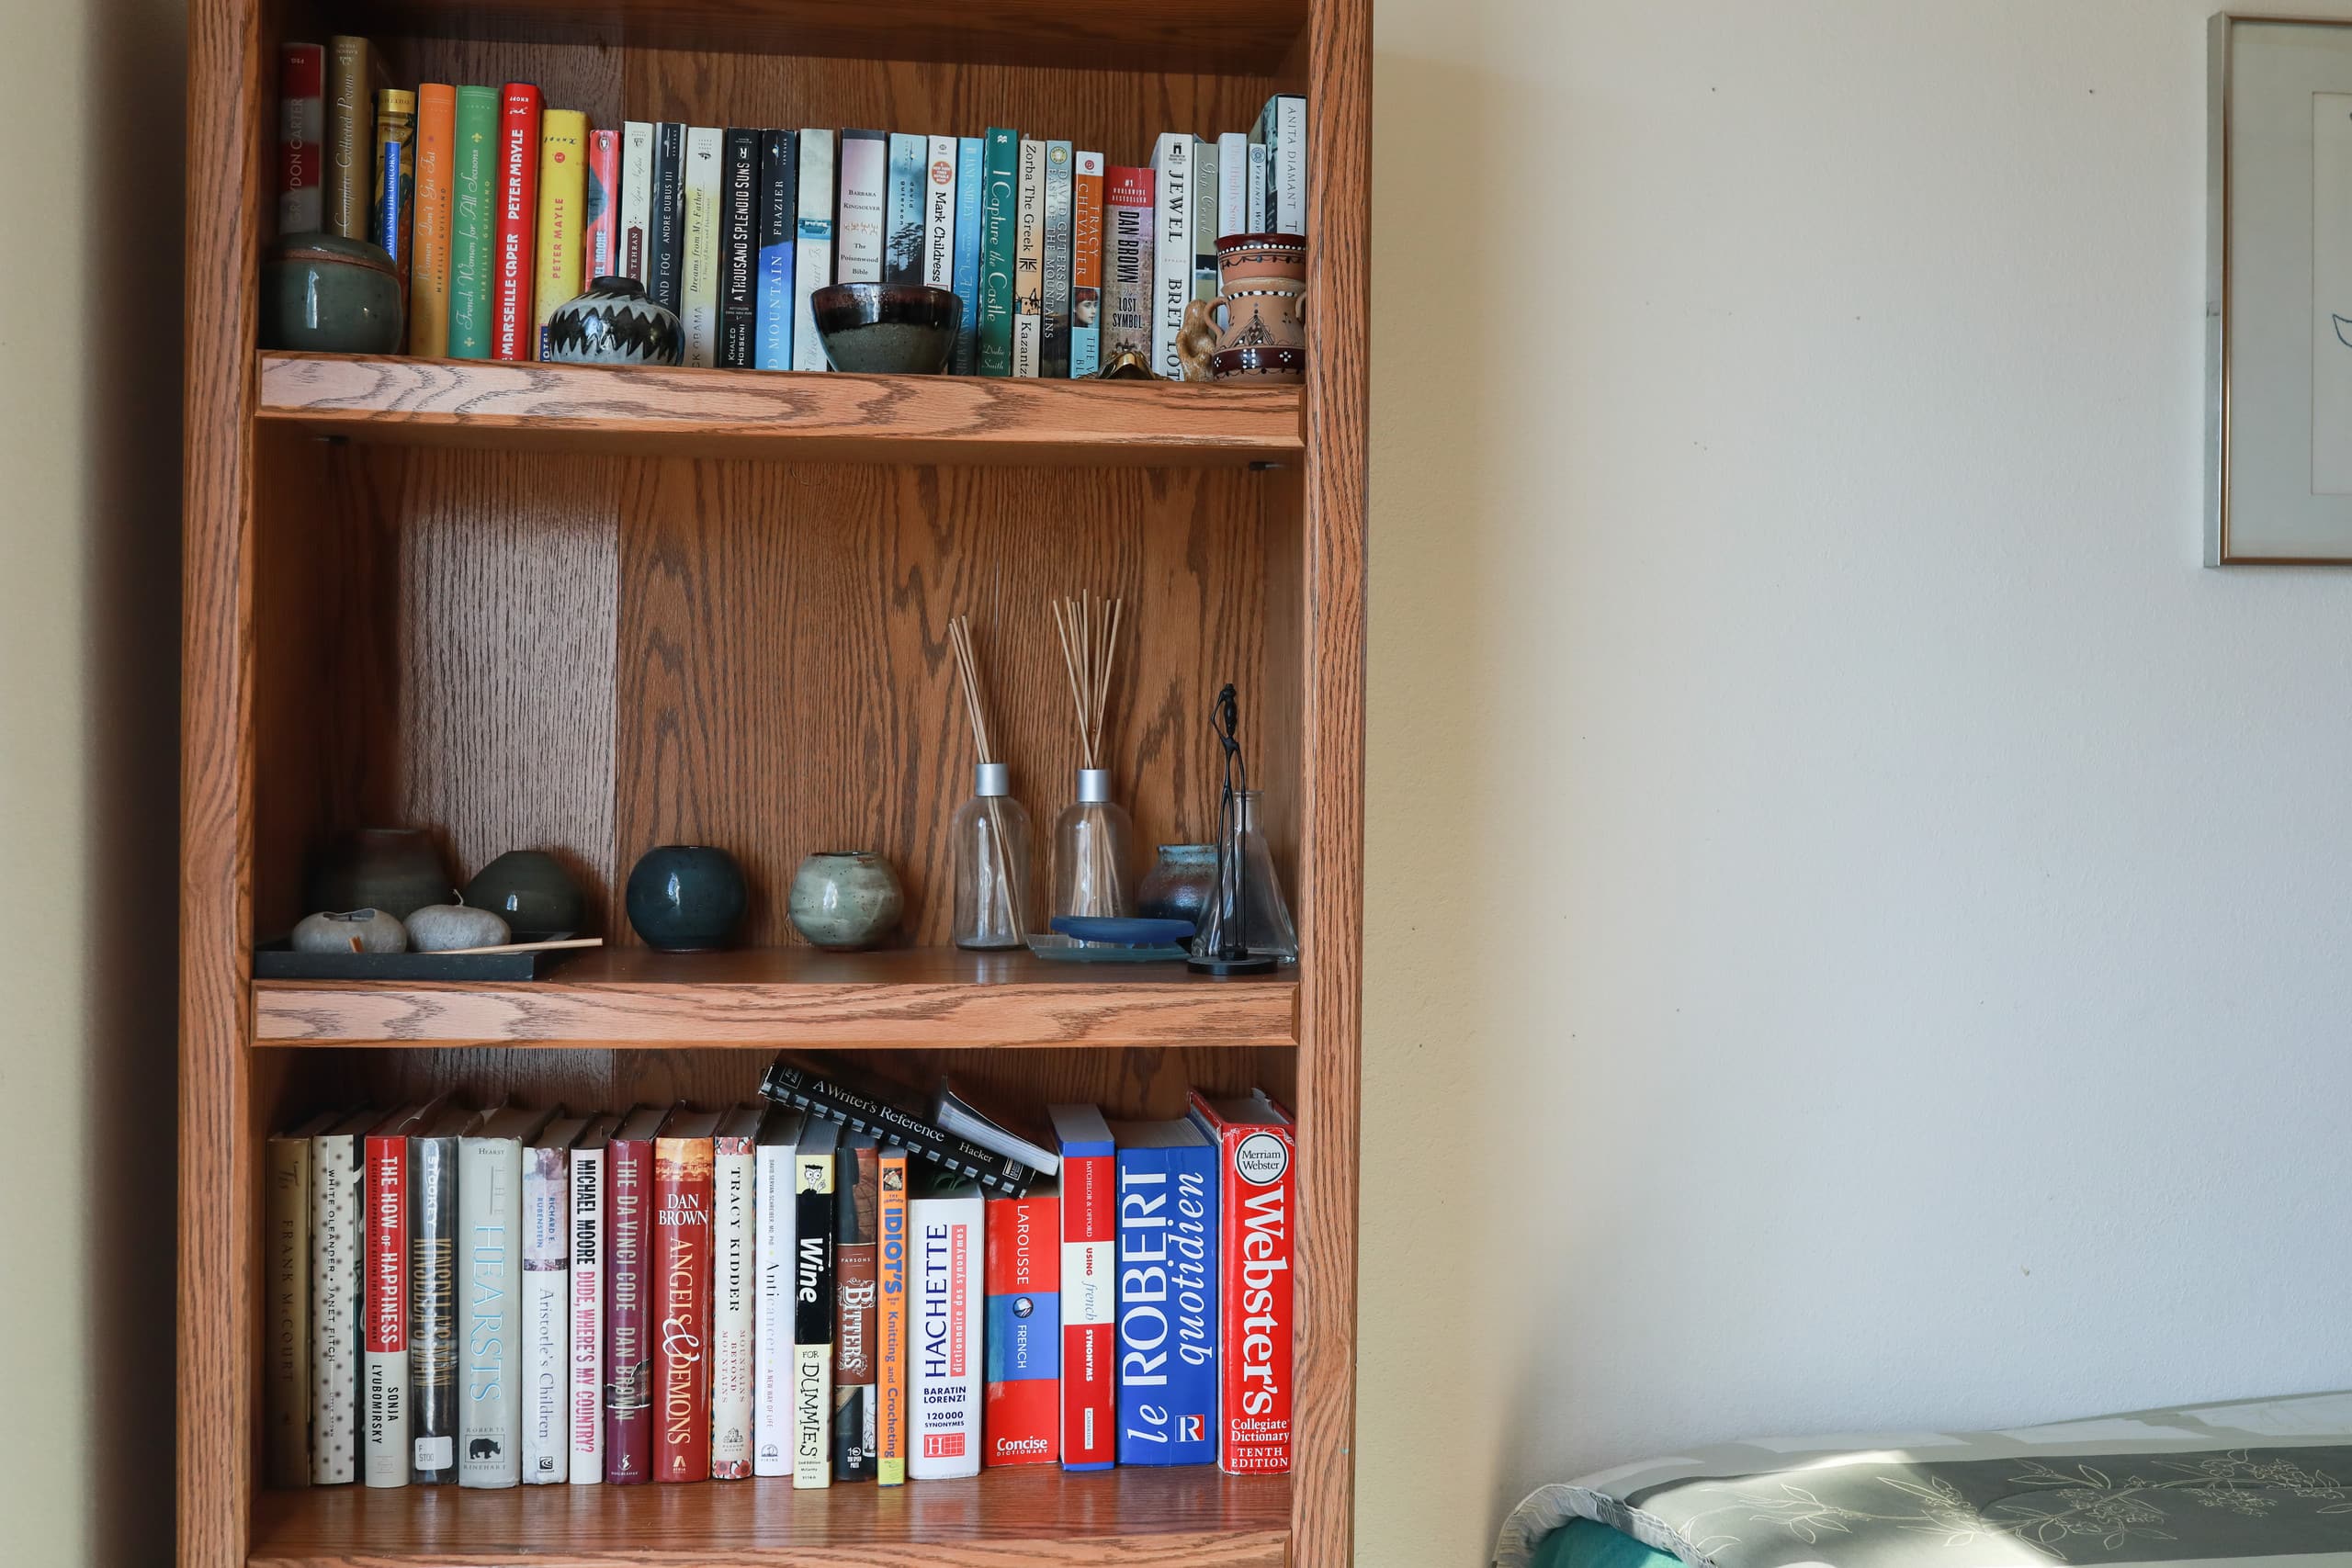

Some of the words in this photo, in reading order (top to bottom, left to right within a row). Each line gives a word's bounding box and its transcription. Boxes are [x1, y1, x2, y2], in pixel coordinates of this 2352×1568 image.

[336, 73, 355, 110] Poems
[289, 97, 303, 151] CARTER
[335, 116, 355, 168] Collected
[1286, 106, 1297, 148] ANITA
[386, 153, 397, 192] UNICORN
[460, 149, 479, 190] Seasons
[508, 129, 524, 177] MAYLE
[1024, 143, 1036, 181] Zorba
[664, 171, 673, 182] III
[734, 162, 751, 188] SUNS
[848, 189, 876, 197] BARBARA
[1047, 168, 1057, 198] EAST
[1113, 187, 1147, 197] WORLDWIDE
[1125, 178, 1134, 187] #1
[1254, 164, 1262, 206] VIRGINIA
[1286, 152, 1297, 209] DIAMANT
[459, 196, 478, 220] All
[481, 180, 491, 238] GUILIANO
[508, 176, 522, 220] PETER
[664, 184, 673, 212] DUBUS
[692, 186, 703, 218] Father
[732, 190, 750, 240] SPLENDID
[774, 180, 784, 235] FRAZIER
[843, 203, 880, 211] KINGSOLVER
[935, 191, 946, 222] Mark
[987, 181, 1012, 245] Capture
[1024, 185, 1035, 209] The
[1047, 207, 1057, 220] OF
[1112, 195, 1147, 204] BESTSELLER
[1168, 169, 1185, 243] JEWEL
[553, 197, 564, 240] MAYLE
[662, 215, 672, 243] ANDRE
[1023, 213, 1035, 252] Greek
[1077, 183, 1088, 276] CHEVALIER
[1088, 205, 1101, 256] TRACY
[1117, 209, 1140, 236] DAN
[503, 233, 519, 279] CAPER
[692, 236, 702, 257] from
[841, 254, 879, 263] Poisonwood
[933, 226, 946, 282] Childress
[1046, 227, 1057, 251] THE
[457, 242, 477, 286] Women
[481, 246, 489, 300] MIREILLE
[551, 243, 562, 279] PETER
[660, 252, 671, 276] FOG
[689, 259, 701, 293] Dreams
[731, 242, 748, 293] THOUSAND
[1056, 221, 1067, 302] GUTERSON
[1116, 239, 1139, 285] BROWN
[456, 290, 474, 330] French
[659, 280, 670, 305] AND
[768, 255, 783, 349] MOUNTAIN
[987, 272, 1008, 322] Castle
[1045, 258, 1057, 338] MOUNTAINS
[1119, 297, 1137, 313] LOST
[1167, 277, 1182, 331] BRET
[502, 279, 517, 353] MARSEILLE
[1112, 312, 1144, 330] SYMBOL
[728, 327, 736, 361] KHALED
[737, 323, 746, 366] HOSSEINI
[1086, 335, 1096, 361] THE
[813, 1080, 826, 1093] A
[828, 1084, 878, 1114] Writer's
[879, 1105, 946, 1143] Reference
[959, 1141, 994, 1164] Hacker
[380, 1156, 398, 1186] THE
[478, 1147, 505, 1156] HEARST
[1239, 1149, 1282, 1160] Merriam
[1241, 1159, 1283, 1171] Webster
[576, 1159, 596, 1215] MICHAEL
[616, 1158, 638, 1188] THE
[380, 1192, 398, 1228] HOW
[548, 1197, 556, 1235] RICHARD
[658, 1210, 709, 1226] BROWN
[667, 1193, 699, 1209] DAN
[729, 1167, 741, 1229] TRACY
[327, 1210, 335, 1272] OLEANDER
[381, 1235, 391, 1247] OF
[536, 1197, 545, 1248] RUBENSTEIN
[548, 1235, 555, 1244] E.
[575, 1219, 595, 1265] MOORE
[616, 1220, 638, 1265] VINCI
[883, 1207, 903, 1295] IDIOT'S
[956, 1227, 966, 1282] synonymes
[1017, 1204, 1030, 1286] LAROUSSE
[1085, 1247, 1093, 1277] USING
[668, 1236, 694, 1325] ANGELS
[729, 1237, 741, 1313] KIDDER
[800, 1237, 824, 1303] Wine
[1121, 1166, 1169, 1386] ROBERT
[1167, 1171, 1212, 1365] quotidien
[327, 1287, 335, 1324] JANET
[380, 1252, 398, 1344] HAPPINESS
[615, 1267, 637, 1312] CODE
[763, 1259, 781, 1356] Anticancer
[925, 1224, 947, 1378] HACHETTE
[955, 1283, 965, 1303] des
[1081, 1280, 1097, 1321] french
[1242, 1180, 1288, 1416] Webster's
[469, 1220, 507, 1403] HEARSTS
[538, 1287, 554, 1367] Aristotle's
[326, 1327, 334, 1362] FITCH
[575, 1308, 594, 1362] WHERE'S
[615, 1326, 636, 1358] DAN
[802, 1349, 820, 1359] FOR
[885, 1310, 899, 1363] Knitting
[952, 1303, 963, 1374] dictionnaire
[1017, 1325, 1027, 1369] FRENCH
[887, 1366, 896, 1383] and
[1085, 1329, 1093, 1382] SYNONYMS
[575, 1367, 594, 1386] MY
[614, 1368, 636, 1422] BROWN
[923, 1385, 967, 1395] BARATIN
[371, 1363, 383, 1445] LYUBOMIRSKY
[386, 1386, 400, 1422] SONJA
[537, 1371, 554, 1439] Children
[666, 1352, 691, 1446] DEMONS
[765, 1405, 773, 1414] OF
[799, 1363, 820, 1459] DUMMIES
[923, 1393, 967, 1404] LORENZI
[466, 1426, 505, 1434] ROBERTS
[574, 1390, 594, 1454] COUNTRY?
[884, 1386, 899, 1459] Crocheting
[924, 1420, 965, 1428] SYNONYMES
[1126, 1403, 1169, 1443] le
[1230, 1418, 1287, 1433] Collegiate
[1230, 1429, 1290, 1443] Dictionary
[419, 1444, 423, 1452] F
[996, 1449, 1048, 1457] DICTIONARY
[997, 1435, 1048, 1451] Concise
[1230, 1457, 1289, 1468] EDITION
[1238, 1447, 1283, 1457] TENTH
[463, 1463, 508, 1472] RINEHART
